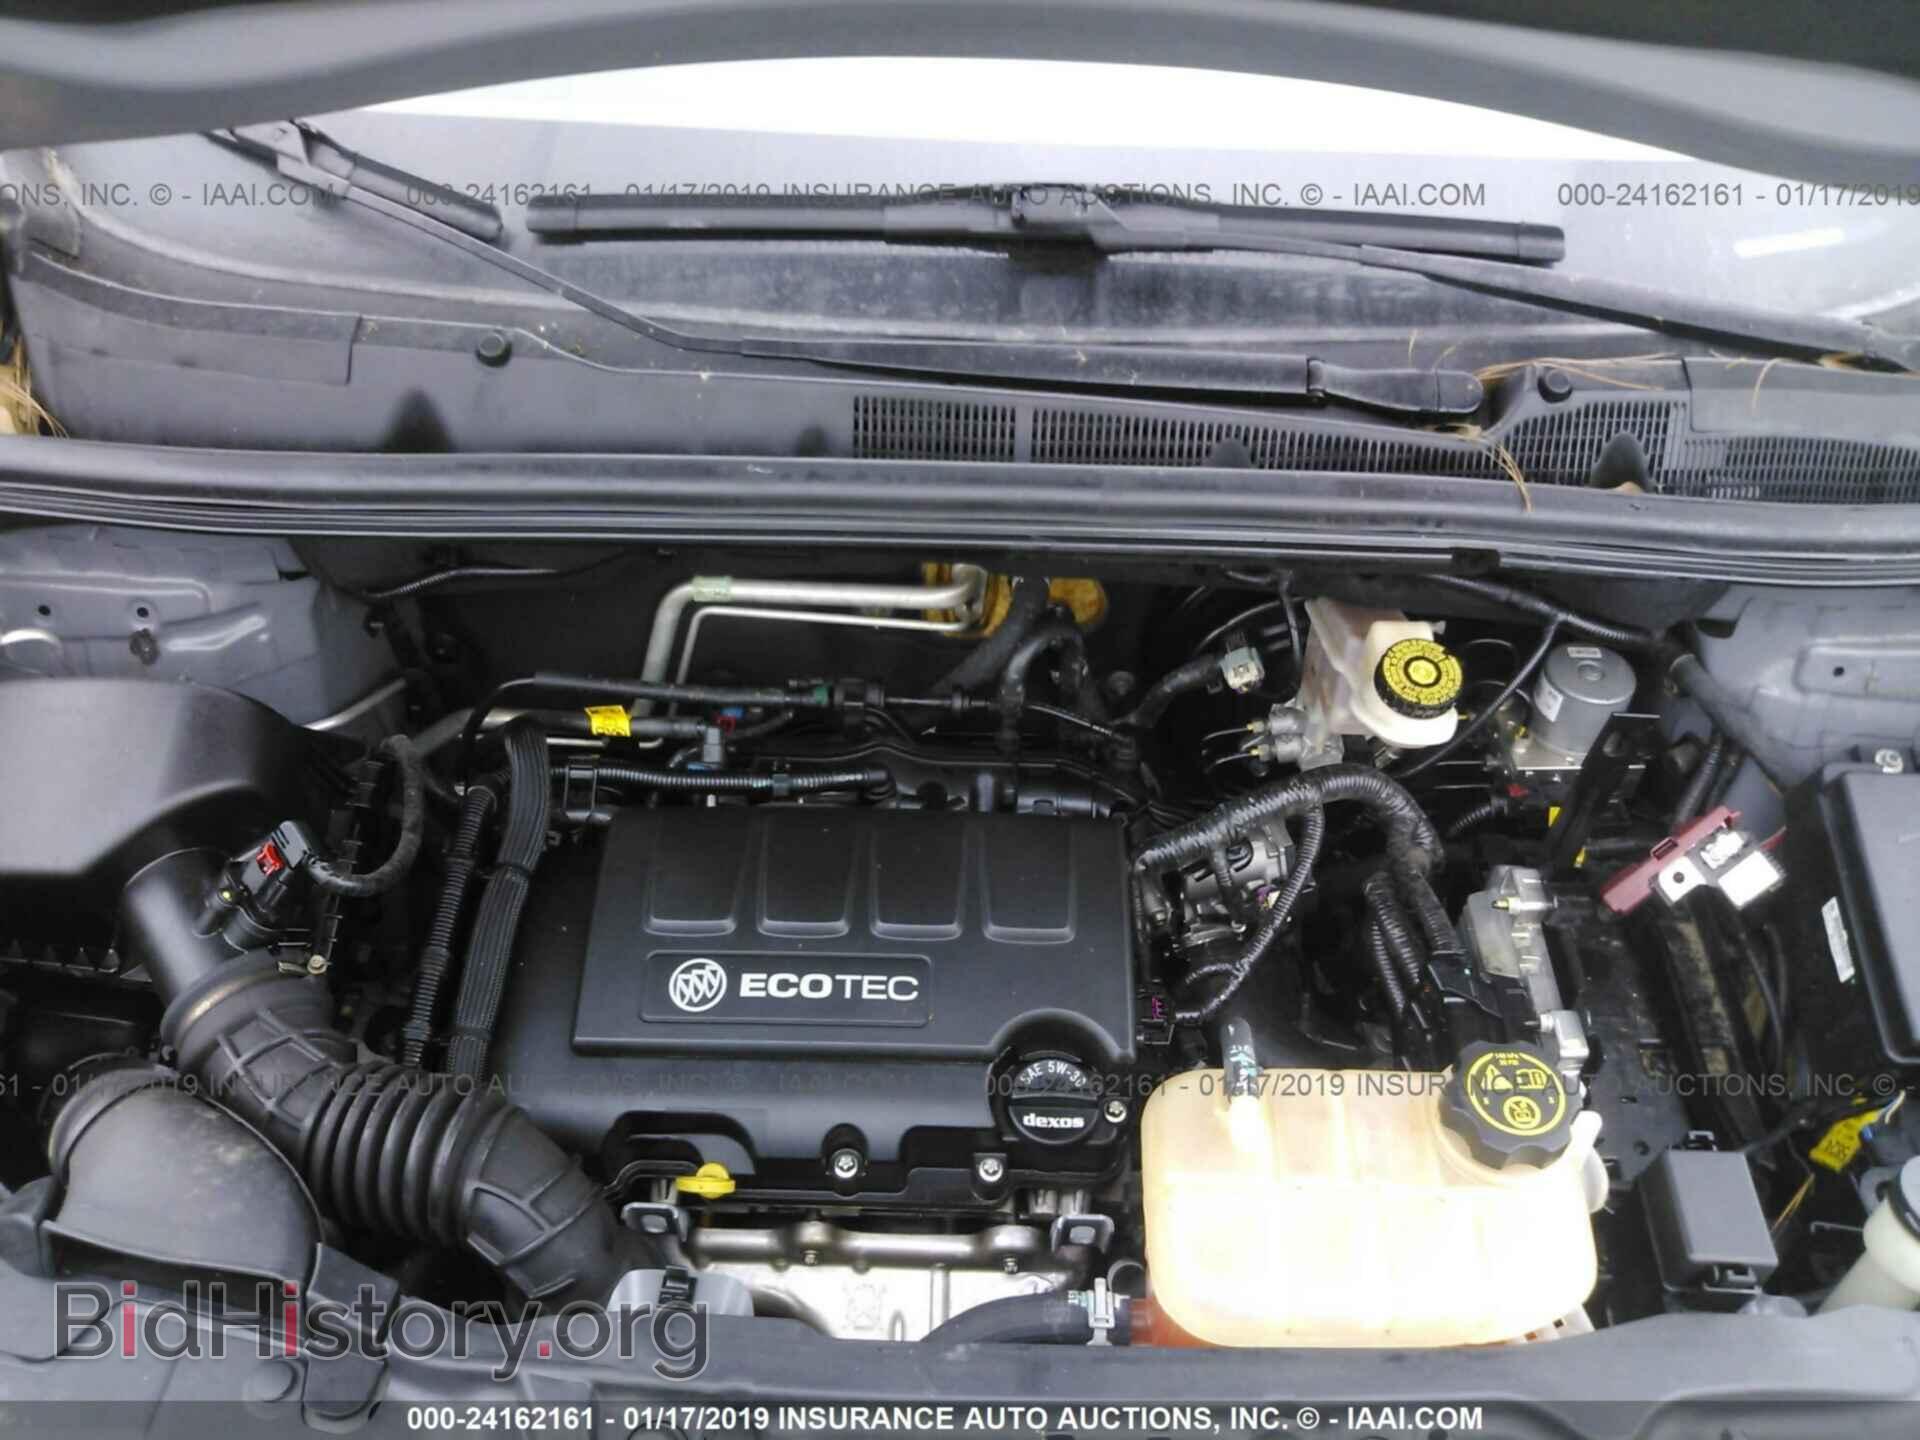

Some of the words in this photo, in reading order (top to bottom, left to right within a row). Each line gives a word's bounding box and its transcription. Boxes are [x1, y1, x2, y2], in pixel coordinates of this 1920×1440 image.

[739, 972, 920, 1002] ECOTEC
[1019, 1063, 1044, 1086] SAE
[1047, 1059, 1087, 1088] 5W-30
[1022, 1112, 1086, 1129] dexos
